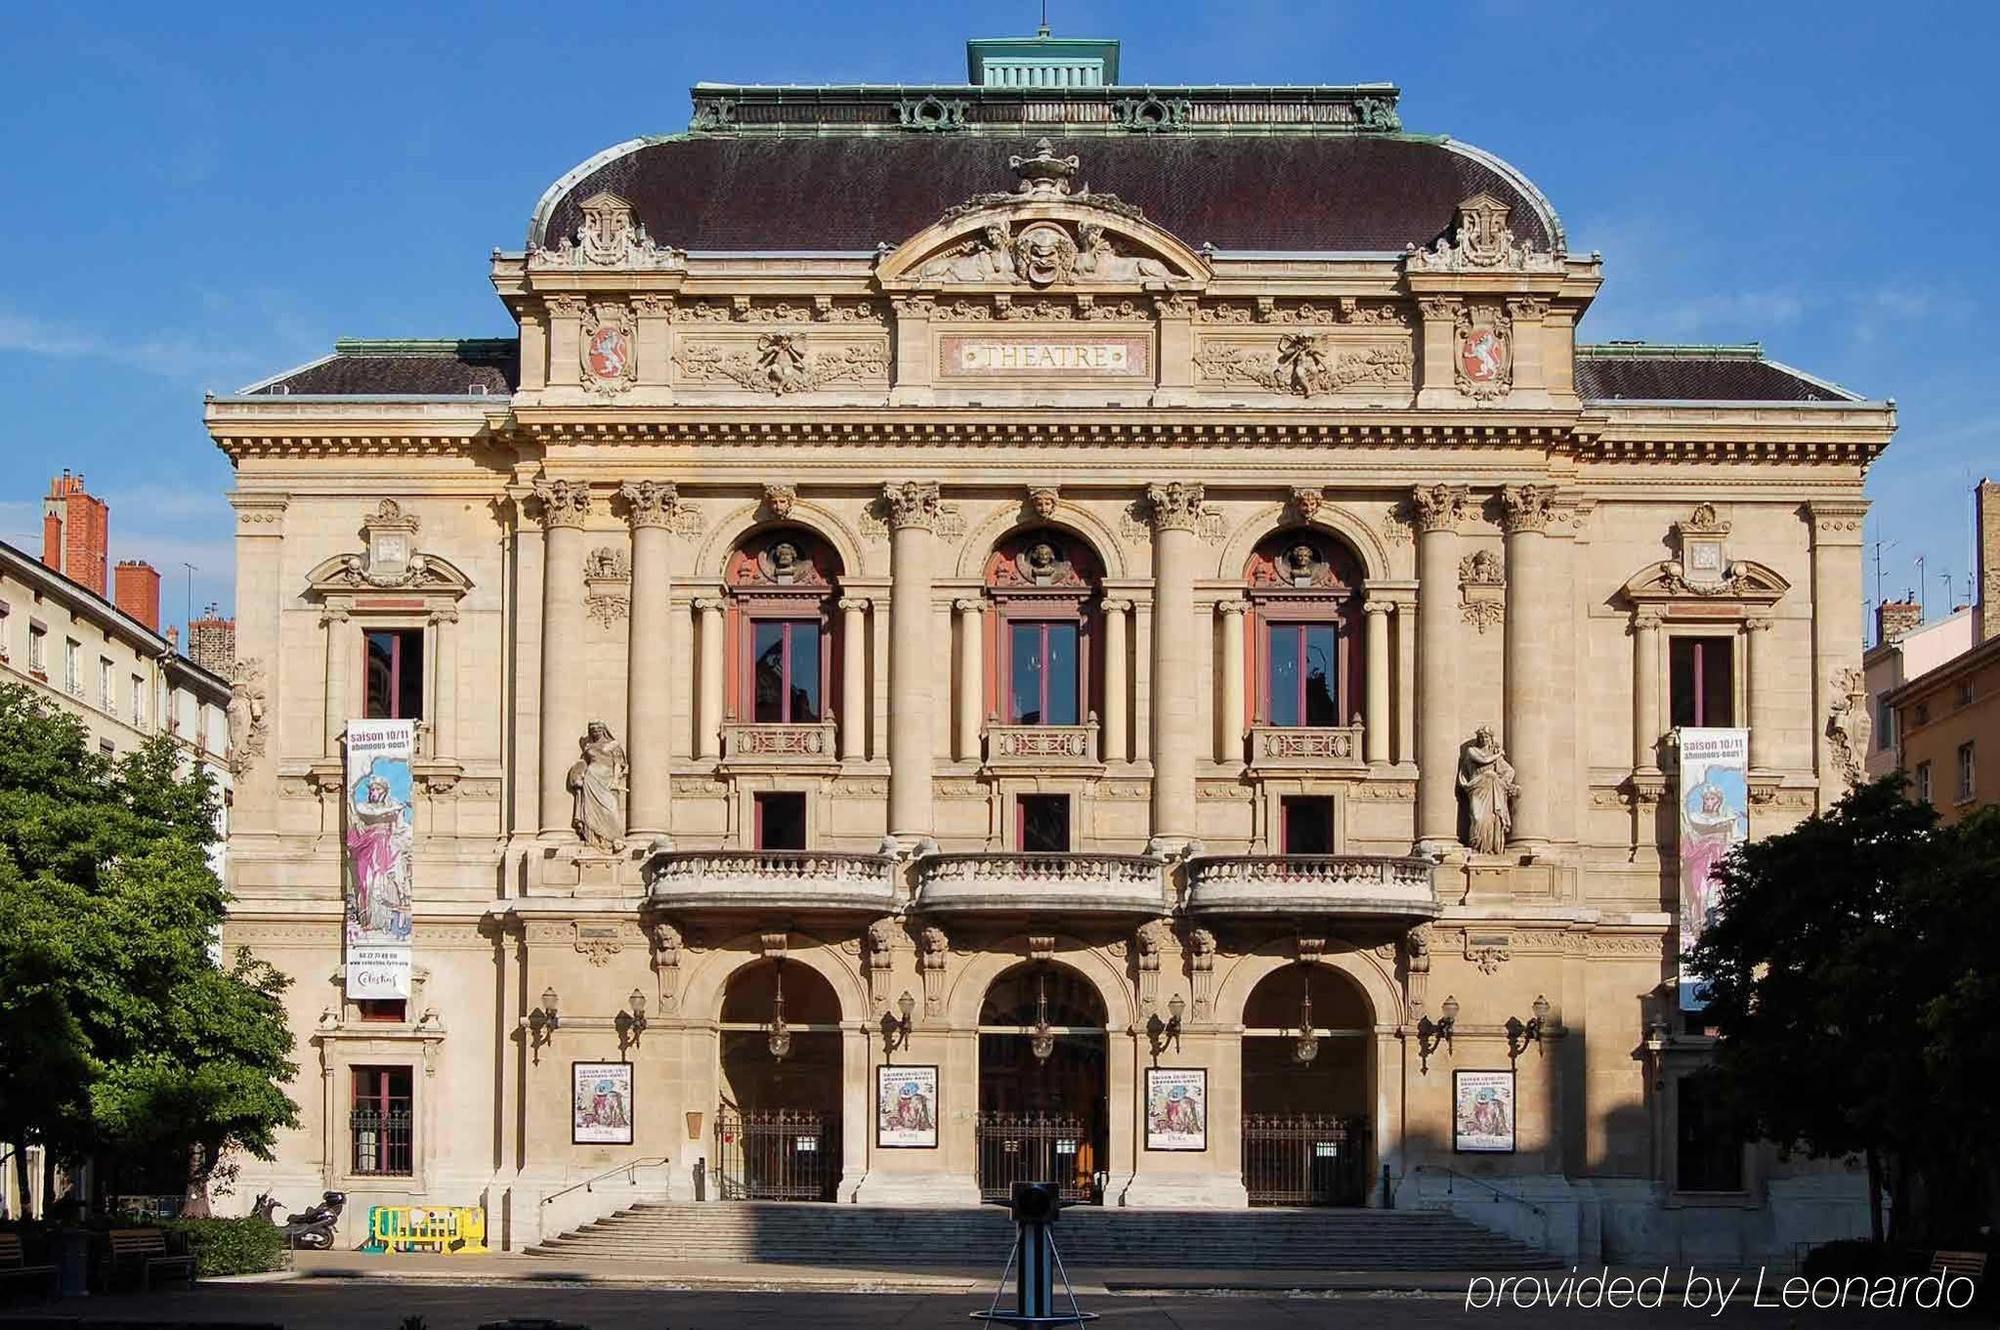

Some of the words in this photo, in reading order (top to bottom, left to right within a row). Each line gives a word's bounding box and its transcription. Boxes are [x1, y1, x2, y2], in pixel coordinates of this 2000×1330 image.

[983, 346, 1108, 367] THEATRE
[351, 732, 384, 742] saison
[387, 730, 409, 740] 10/11
[1683, 740, 1717, 751] saison
[1720, 739, 1743, 749] 10/11
